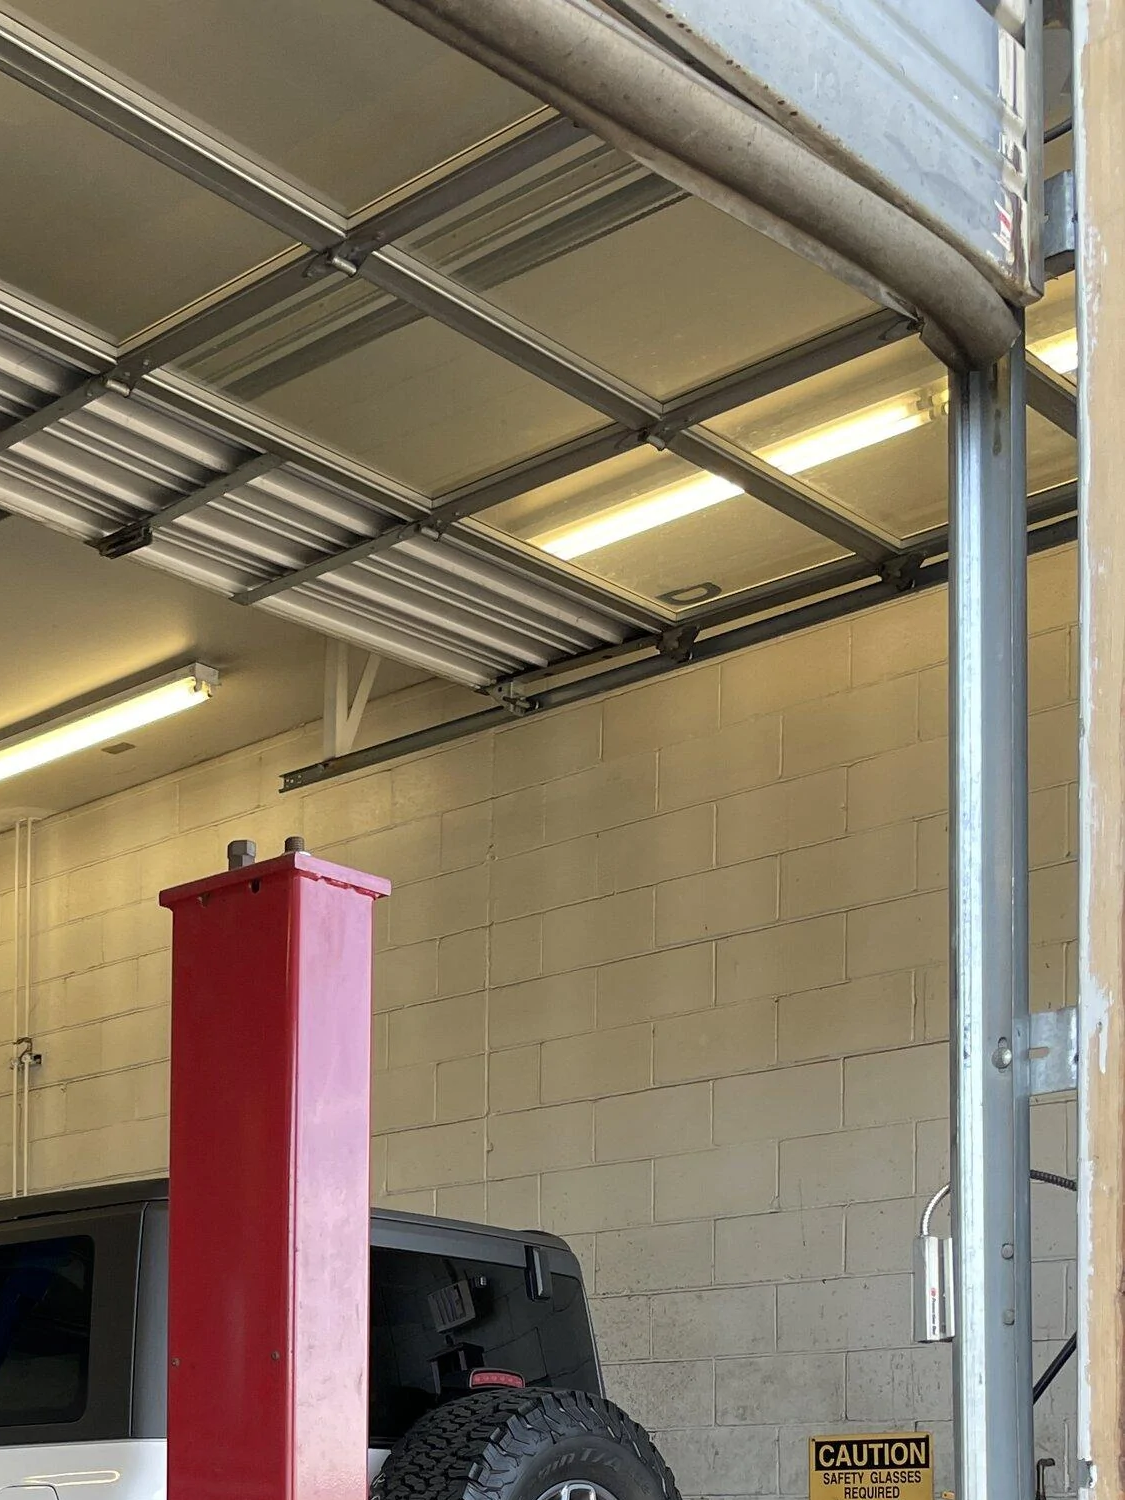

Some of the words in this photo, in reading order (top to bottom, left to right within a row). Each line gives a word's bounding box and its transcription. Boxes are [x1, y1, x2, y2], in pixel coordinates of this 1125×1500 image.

[818, 1442, 925, 1467] CAUTION
[823, 1472, 864, 1484] SAFETY
[870, 1470, 921, 1483] GLASSES
[844, 1486, 900, 1499] REQUIRED
